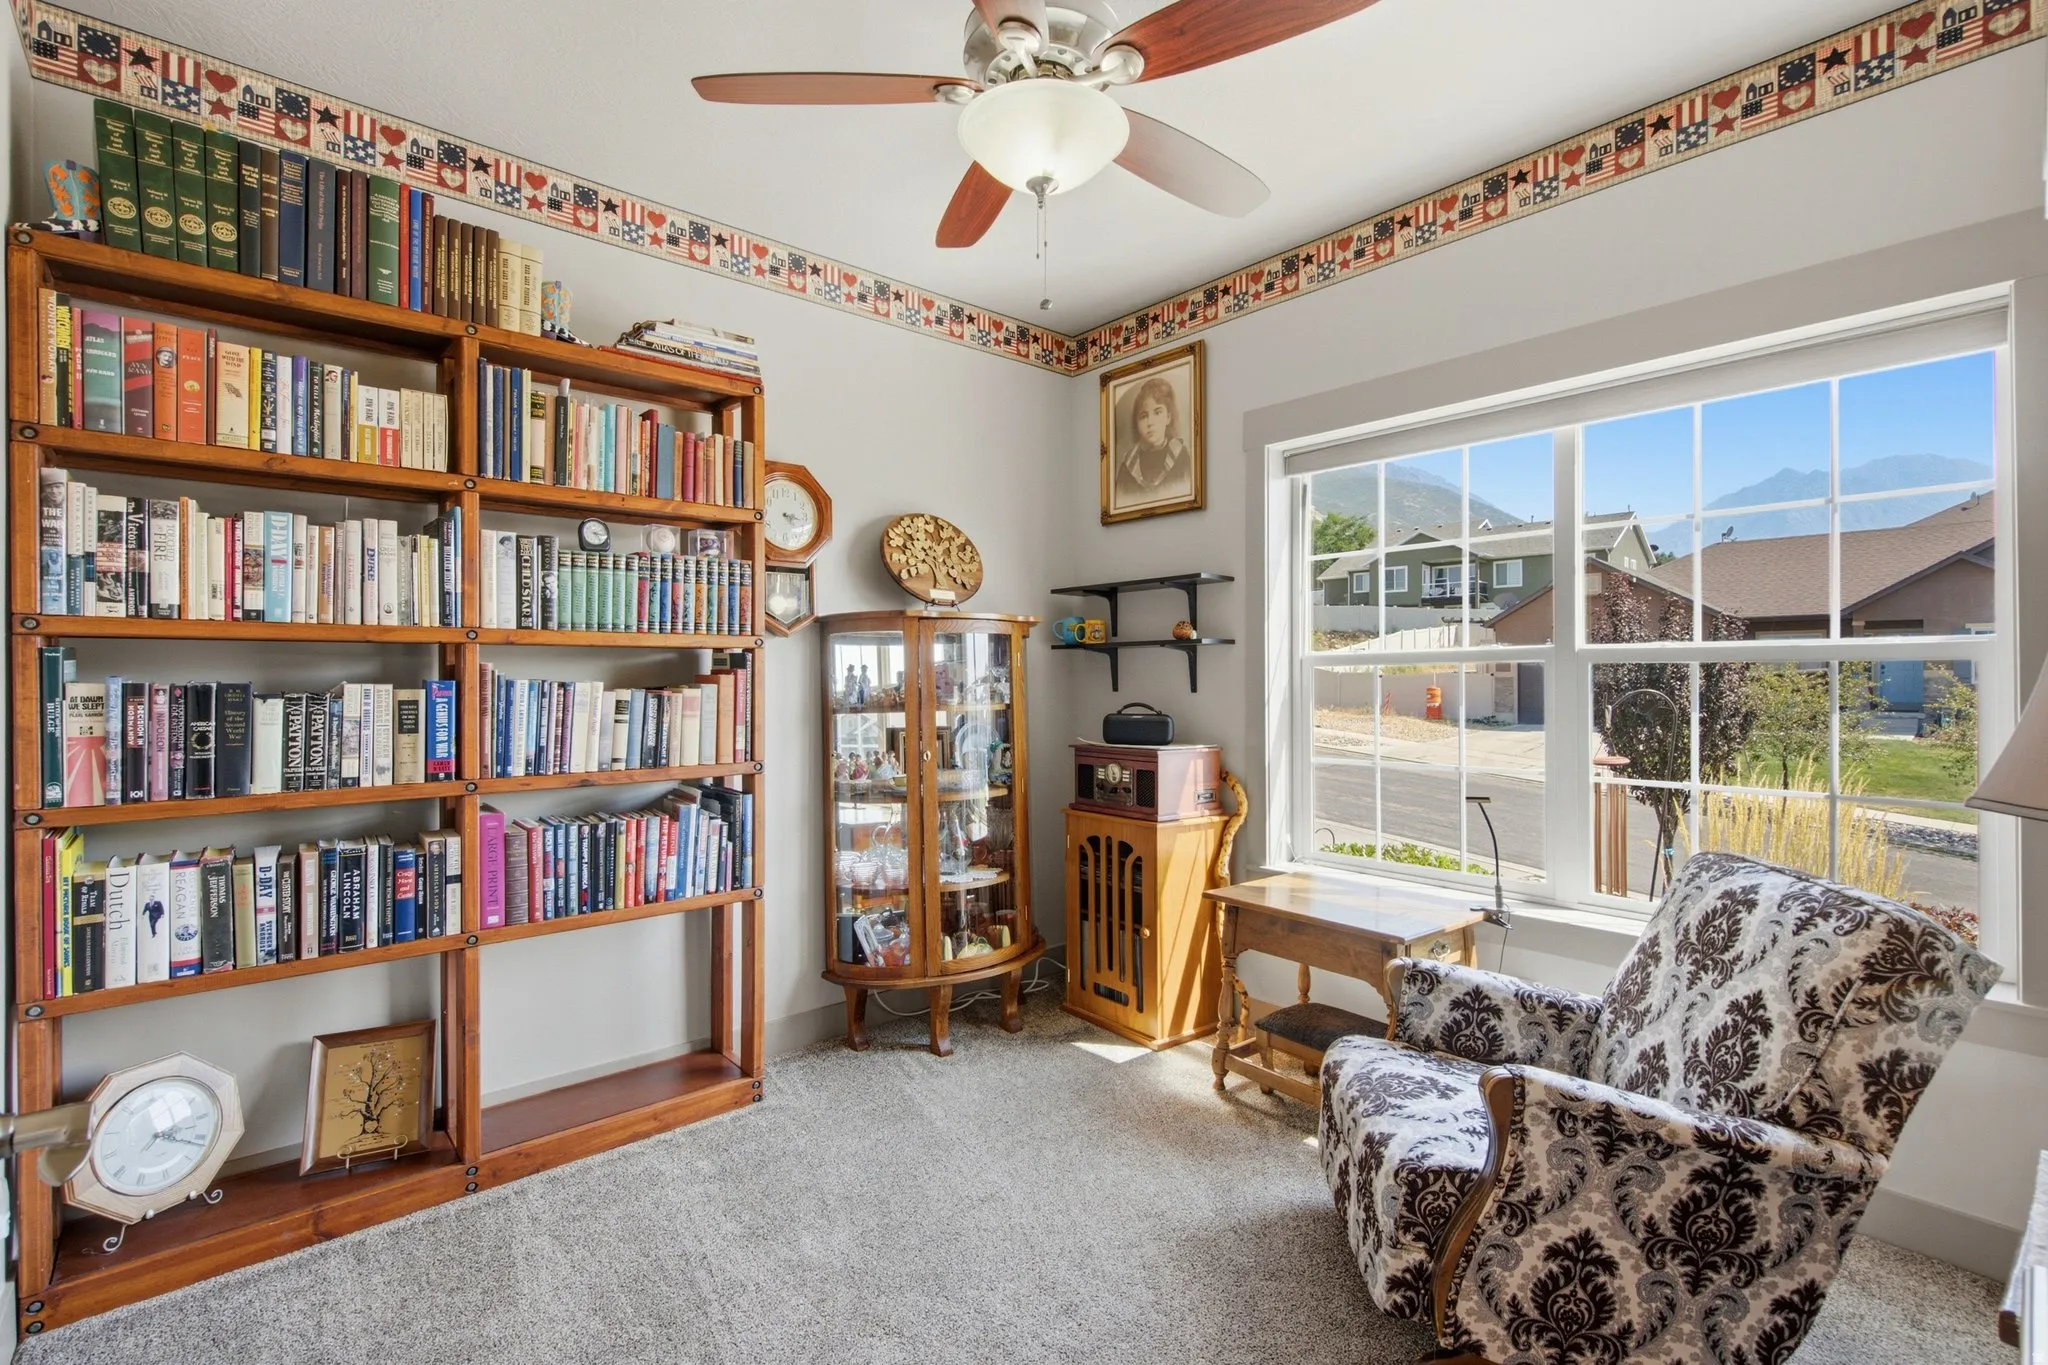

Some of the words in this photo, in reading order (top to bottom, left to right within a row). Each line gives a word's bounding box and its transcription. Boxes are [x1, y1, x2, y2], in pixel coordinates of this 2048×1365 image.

[48, 295, 56, 334] WONDER
[56, 306, 71, 349] WATCHMEN
[48, 338, 56, 372] WOMAN
[652, 342, 674, 354] ATLAS
[675, 349, 686, 358] OF
[365, 398, 374, 408] AYN
[365, 409, 374, 422] RAND
[386, 412, 395, 425] RAND
[311, 407, 322, 444] Mockingbird
[41, 519, 64, 529] WAR
[43, 507, 63, 516] THE
[128, 513, 144, 549] Victors
[167, 524, 176, 561] TOUCHED
[154, 533, 167, 561] FIRE
[367, 548, 376, 581] DUKE
[521, 556, 532, 587] CHILD
[128, 588, 136, 615] AMBROSE
[521, 589, 532, 616] STAR
[82, 702, 105, 710] SLEPT
[376, 689, 384, 723] AMBROSE
[384, 688, 392, 718] STEPHEN
[436, 703, 449, 727] GENIUS
[127, 705, 135, 745] NORMANDY
[137, 705, 145, 736] DECISION
[156, 712, 165, 753] NAPOLEON
[170, 719, 178, 742] PATTON
[436, 728, 449, 741] FOR
[288, 714, 302, 767] PATTON
[309, 714, 325, 766] PATTON
[375, 728, 383, 759] SOLDIERS
[383, 728, 392, 759] CITIZEN
[436, 742, 449, 758] WAR
[488, 827, 498, 866] LARGE
[660, 835, 668, 865] RETURN
[89, 890, 98, 907] TEAM
[109, 872, 131, 931] Dutch
[175, 871, 186, 920] REAGAN
[208, 875, 219, 918] JEFFERSON
[218, 875, 227, 903] THOMAS
[281, 877, 291, 898] CUSTER
[343, 872, 351, 919] LINCOLN
[352, 869, 361, 920] ABRAHAM
[488, 870, 498, 904] PRINT
[80, 894, 90, 914] RIVALS
[282, 898, 291, 914] STORY
[329, 895, 337, 936] WASHINGTON
[259, 923, 267, 953] AMBROSE
